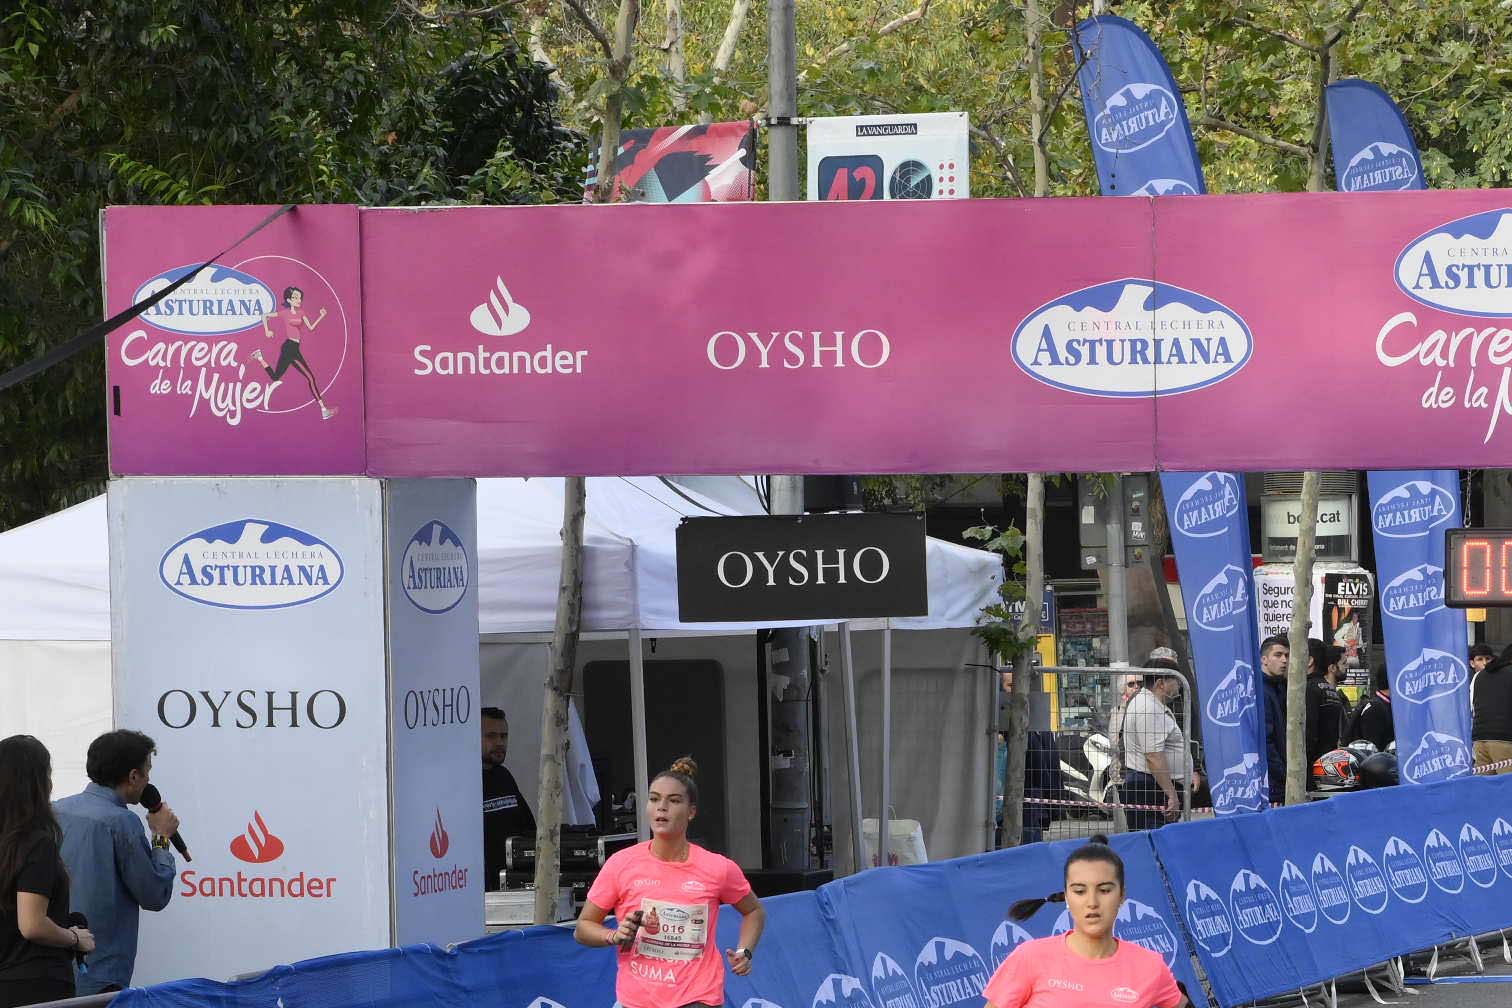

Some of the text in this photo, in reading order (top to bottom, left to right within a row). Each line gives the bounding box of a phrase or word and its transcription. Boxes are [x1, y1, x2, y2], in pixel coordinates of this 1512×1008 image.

[145, 289, 263, 316] ASTURIANA
[1067, 320, 1225, 331] CENTRAL LECHERA
[121, 330, 238, 367] Carrera
[413, 344, 588, 376] Santander
[706, 329, 891, 370] OYSHO
[1030, 323, 1234, 366] ASTURIANA
[151, 364, 283, 426] de la Mujer
[1422, 371, 1456, 408] de
[1464, 368, 1488, 408] la
[174, 553, 330, 587] ASTURIANA
[203, 550, 324, 560] CENTRAL LECHERA
[717, 546, 890, 588] OYSHO
[407, 555, 465, 590] ASTURIANA
[1338, 583, 1368, 595] ELVIS
[157, 689, 347, 729] OYSHO
[404, 685, 470, 730] OYSHO
[181, 871, 337, 898] Santander
[413, 864, 468, 898] Santander
[662, 924, 685, 934] 016
[630, 961, 676, 983] SUMA
